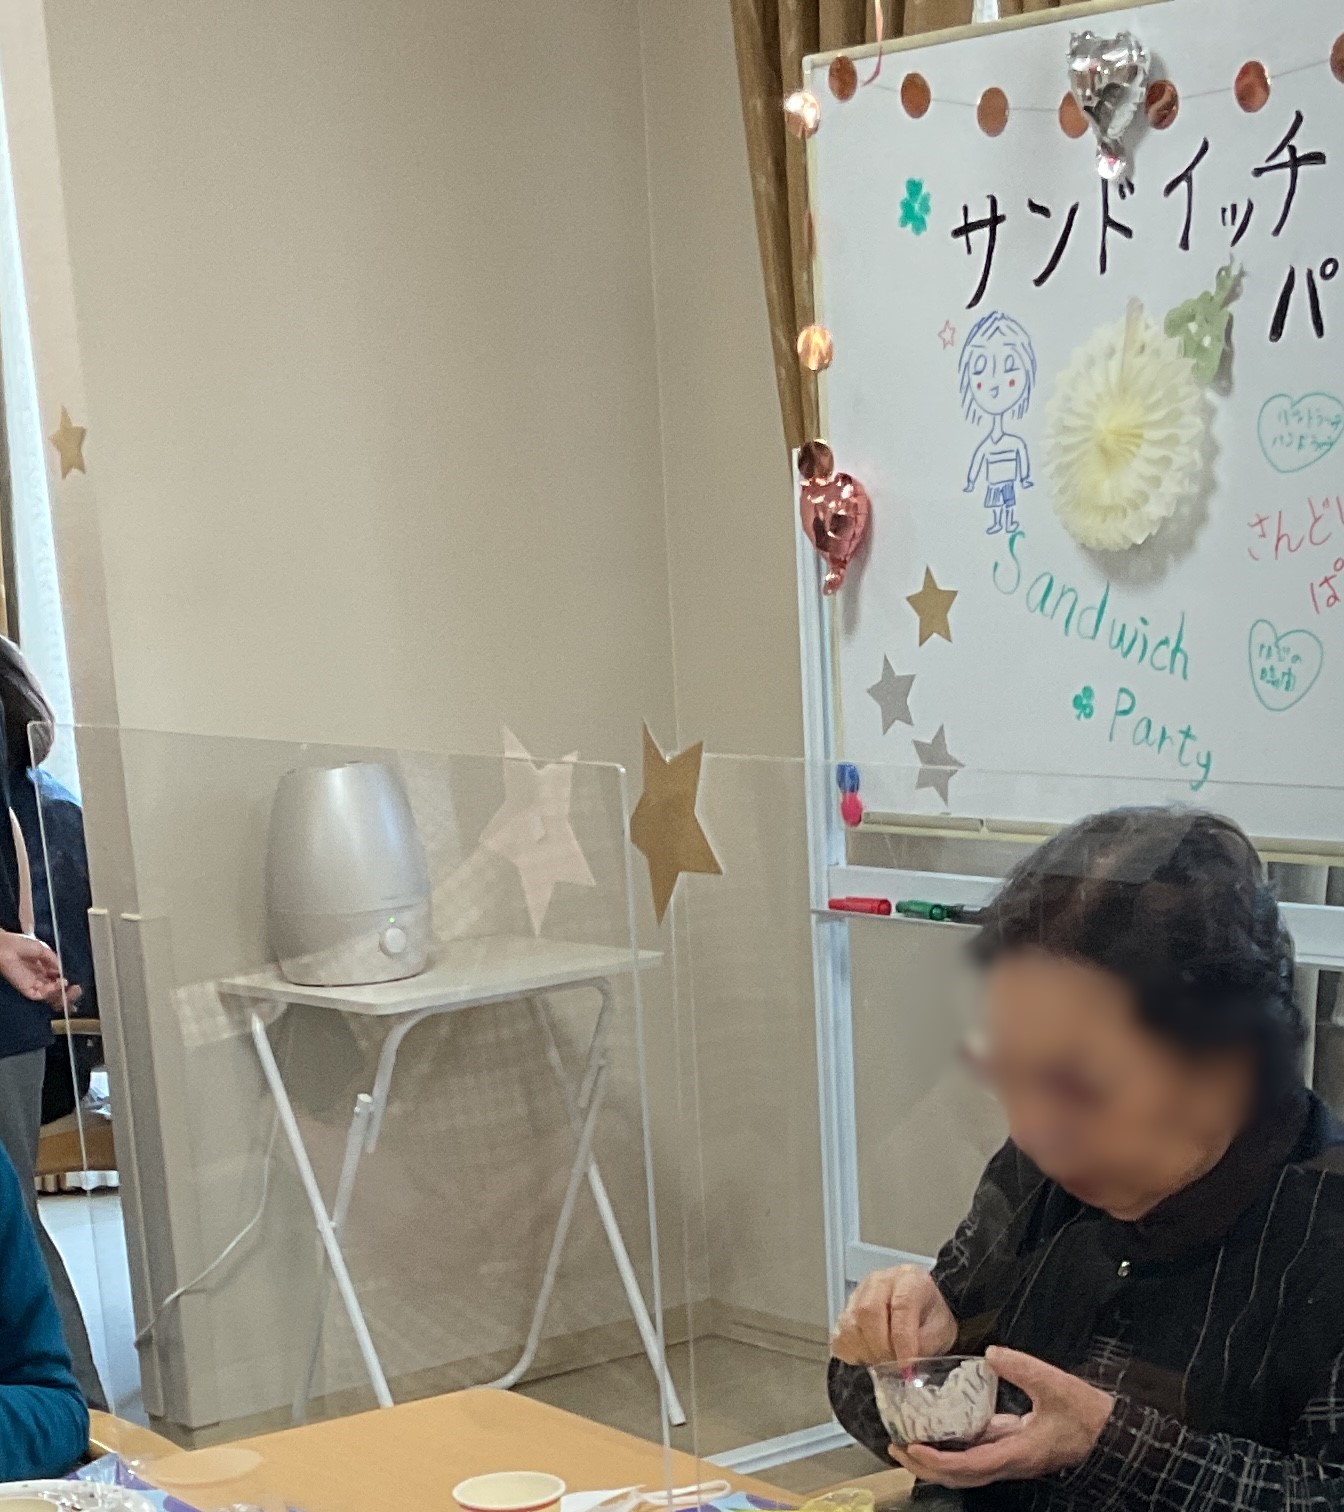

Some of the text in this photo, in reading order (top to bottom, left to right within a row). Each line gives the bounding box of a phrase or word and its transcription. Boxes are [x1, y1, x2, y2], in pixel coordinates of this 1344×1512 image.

[950, 110, 1328, 310] サンドイッチ
[991, 530, 1191, 682] Sandwich
[1107, 687, 1214, 792] Party
